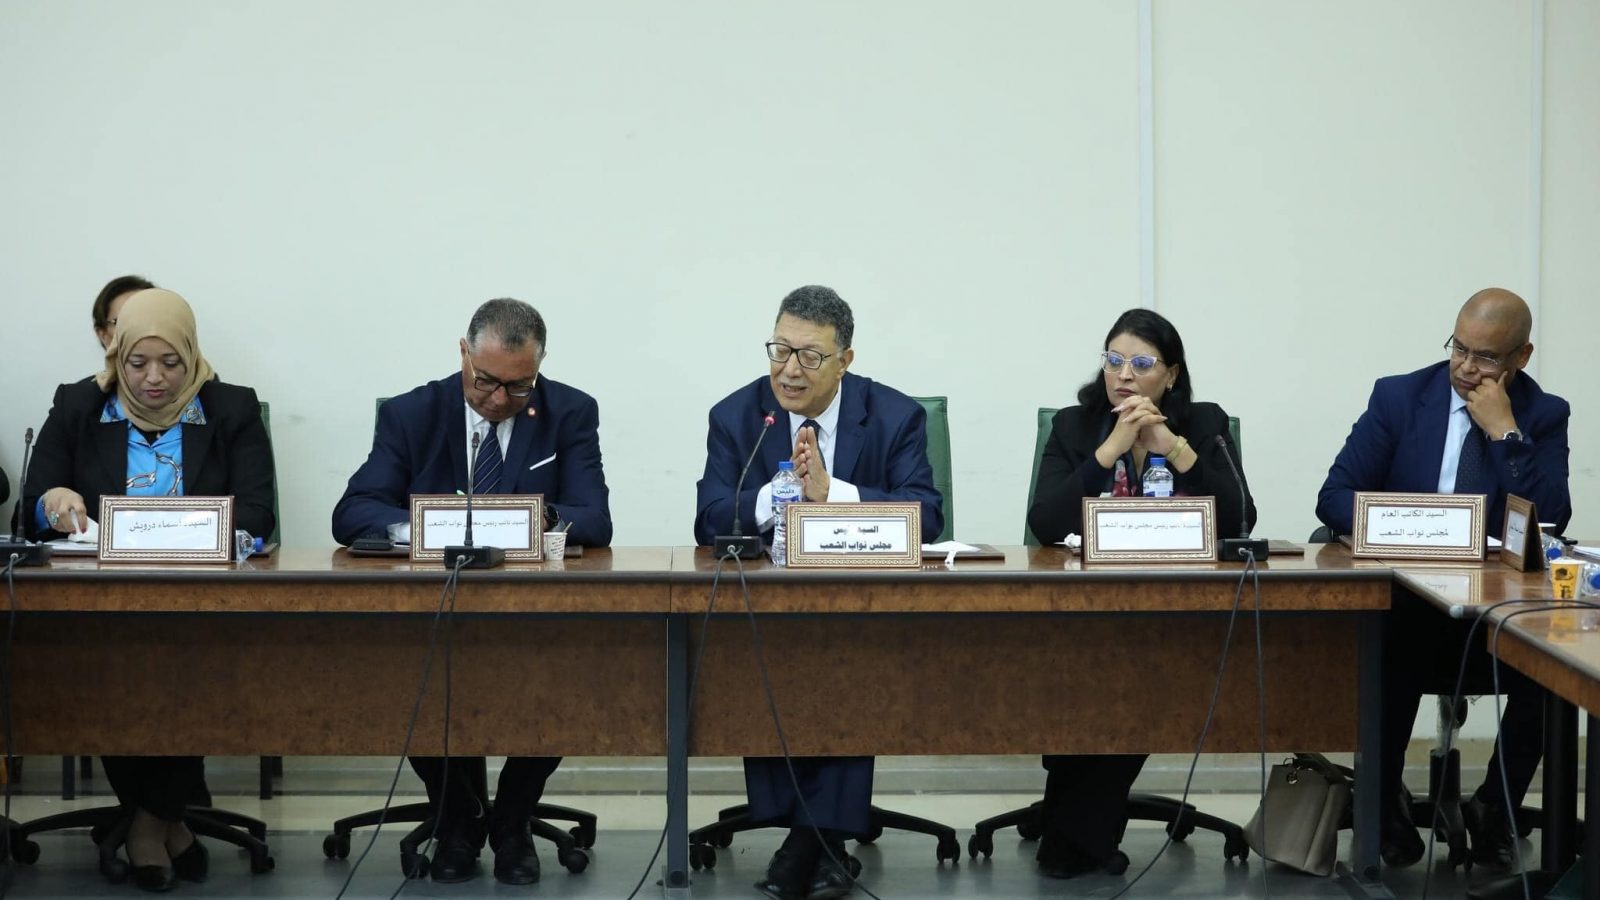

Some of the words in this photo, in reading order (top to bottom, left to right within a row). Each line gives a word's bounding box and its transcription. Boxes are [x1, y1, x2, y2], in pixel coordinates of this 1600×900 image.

[1381, 509, 1399, 520] العام
[1401, 509, 1424, 518] الكاتب
[1426, 509, 1447, 518] السيد
[129, 521, 156, 533] درويش
[183, 517, 212, 528] السيد
[1379, 528, 1405, 538] الشعب
[1407, 528, 1424, 538] نواب
[1426, 528, 1448, 538] لمجلس
[819, 540, 847, 551] الشعب
[848, 541, 867, 551] نواب
[869, 541, 892, 551] مجلس
